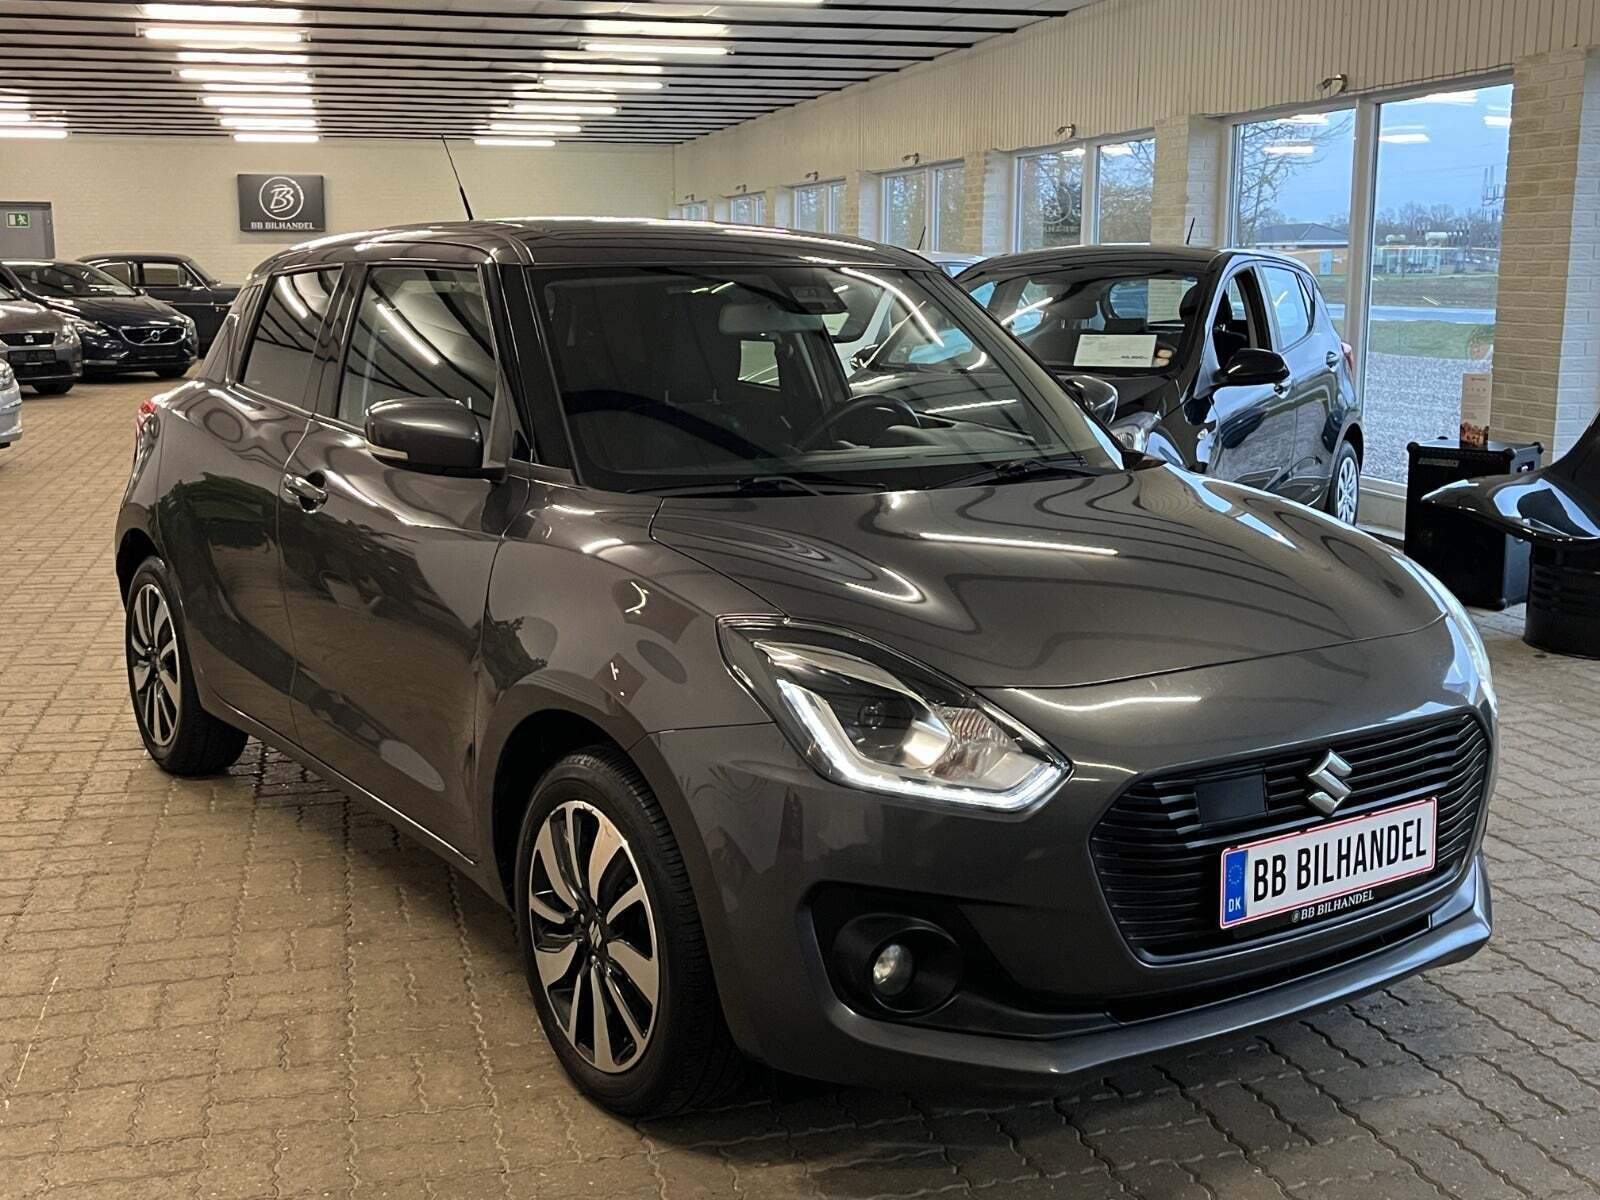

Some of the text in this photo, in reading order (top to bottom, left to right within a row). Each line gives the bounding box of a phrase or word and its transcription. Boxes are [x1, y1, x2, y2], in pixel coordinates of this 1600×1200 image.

[250, 221, 315, 230] BB BILHANDEL
[1254, 818, 1426, 902] BB BILHANDEL
[1229, 897, 1241, 912] DK
[1301, 906, 1315, 920] BB
[1317, 890, 1374, 915] BILHANDEL
